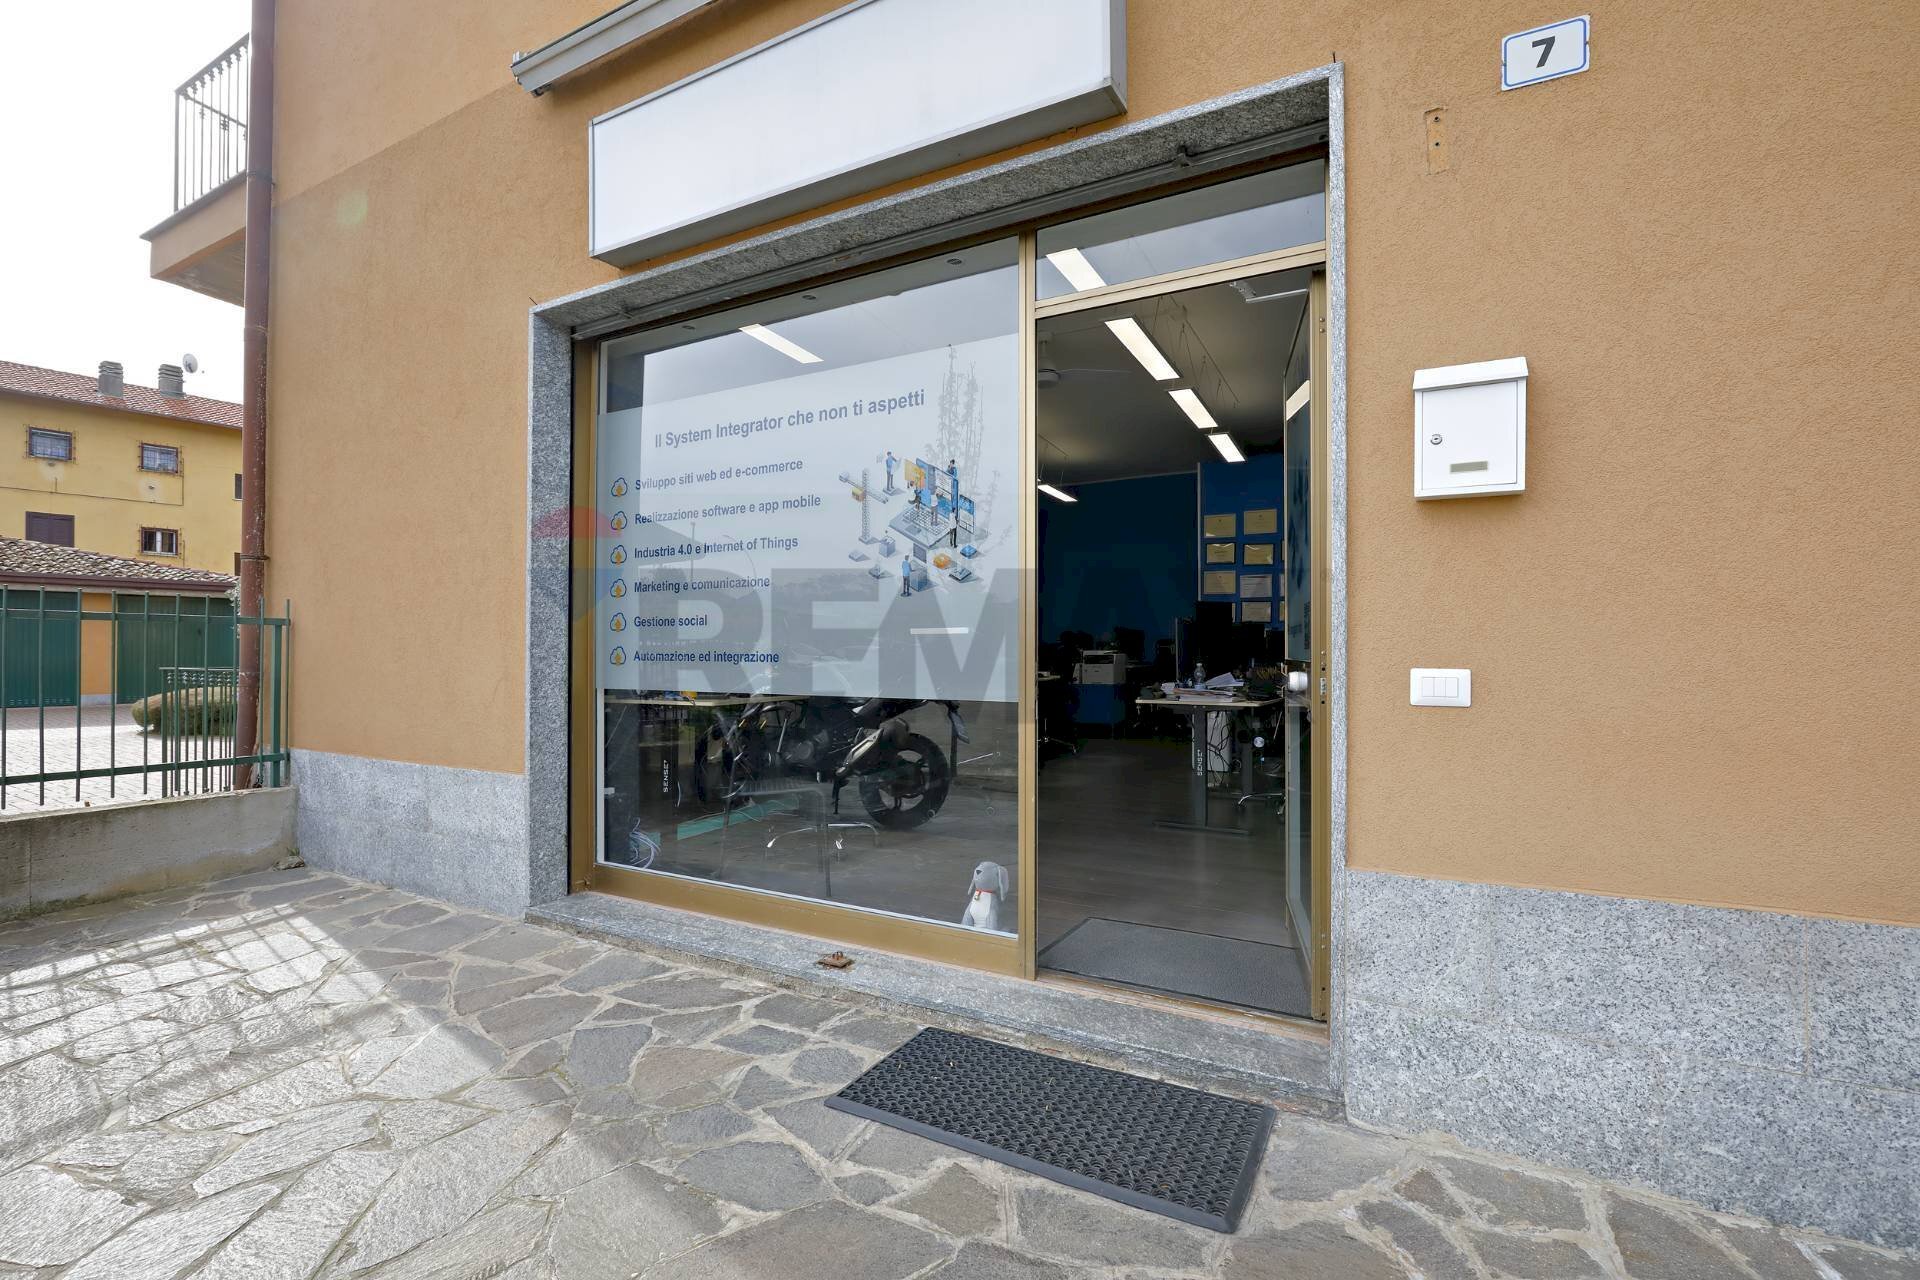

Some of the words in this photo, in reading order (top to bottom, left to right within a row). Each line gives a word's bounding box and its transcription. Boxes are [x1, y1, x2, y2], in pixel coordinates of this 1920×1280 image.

[1531, 35, 1556, 69] 7
[655, 434, 662, 448] Il
[665, 428, 712, 449] System
[716, 414, 784, 439] Integrator
[787, 410, 814, 427] che
[819, 404, 848, 422] non
[852, 400, 863, 417] ti
[868, 389, 925, 415] aspetti
[635, 475, 676, 491] Sviluppo
[679, 472, 694, 485] siti
[696, 469, 717, 482] web
[719, 467, 732, 479] ed
[735, 459, 803, 478] e-commerce
[635, 508, 699, 525] Realizzazione
[702, 503, 746, 518] software
[749, 504, 755, 513] e
[758, 501, 779, 516] app
[782, 494, 821, 509] mobile
[634, 545, 676, 559] Industria
[678, 543, 692, 556] 4.0
[695, 546, 701, 554] e
[704, 540, 743, 554] Internet
[746, 538, 758, 550] of
[760, 536, 799, 551] Things
[634, 580, 680, 594] Marketing
[683, 581, 689, 591] e
[691, 576, 770, 590] comunicazione
[634, 616, 676, 628] Gestione
[678, 614, 708, 627] social
[633, 651, 696, 662] Automazione
[698, 651, 711, 662] ed
[713, 651, 780, 665] integrazione
